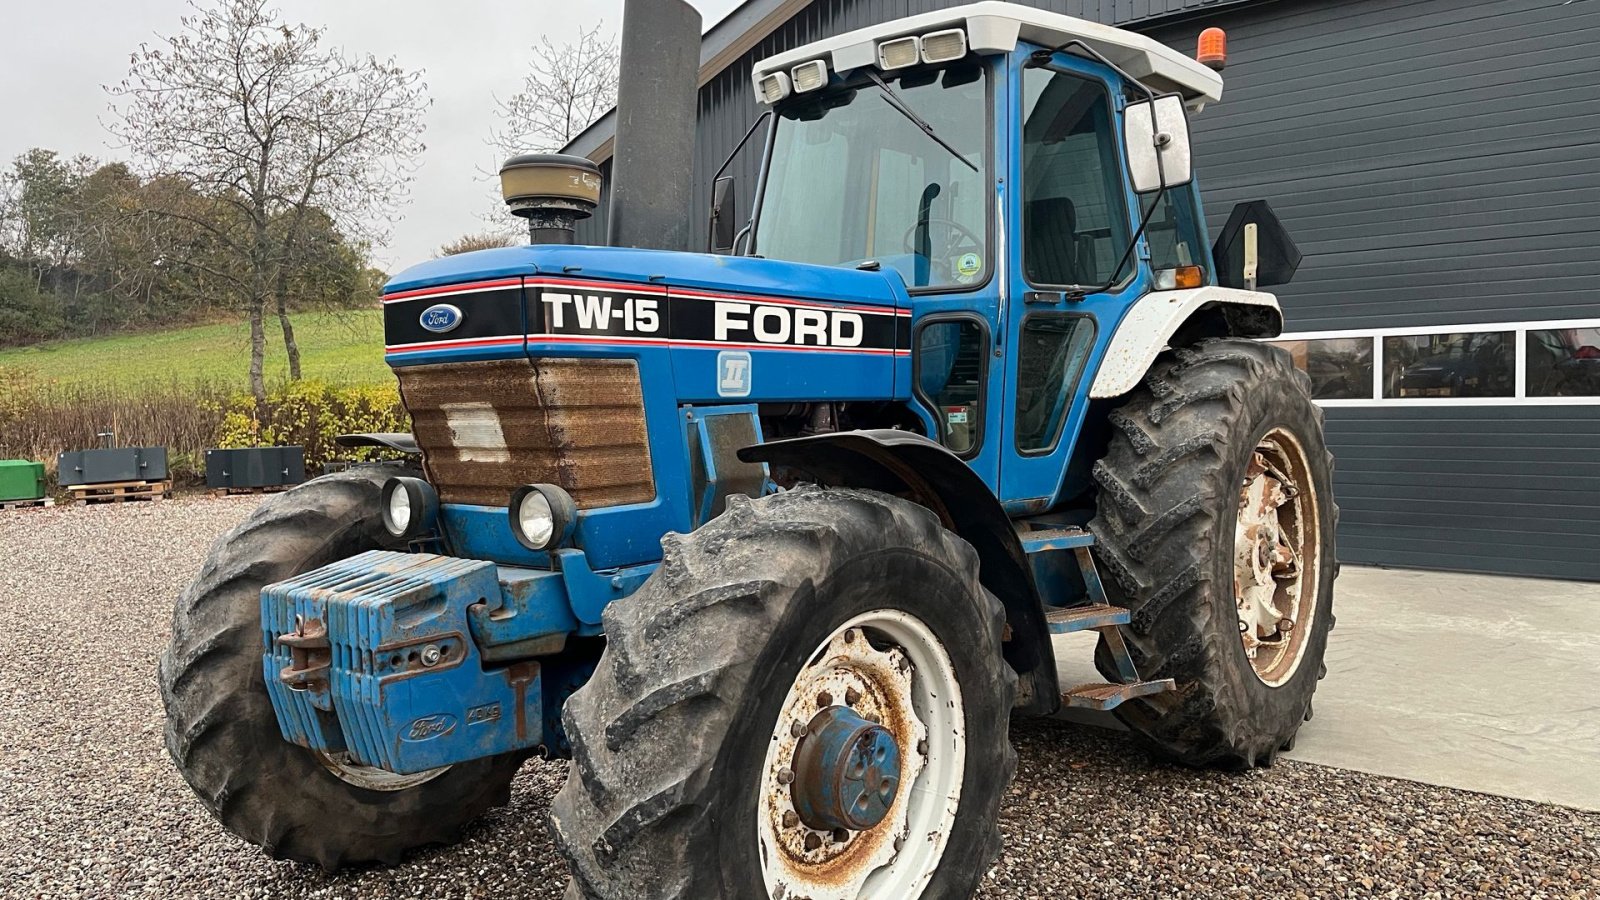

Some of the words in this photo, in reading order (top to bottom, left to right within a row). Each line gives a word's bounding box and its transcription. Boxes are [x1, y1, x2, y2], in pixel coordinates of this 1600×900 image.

[427, 310, 449, 325] Ford
[541, 293, 659, 332] TW-15
[714, 302, 863, 347] FORD
[408, 715, 447, 739] Ford
